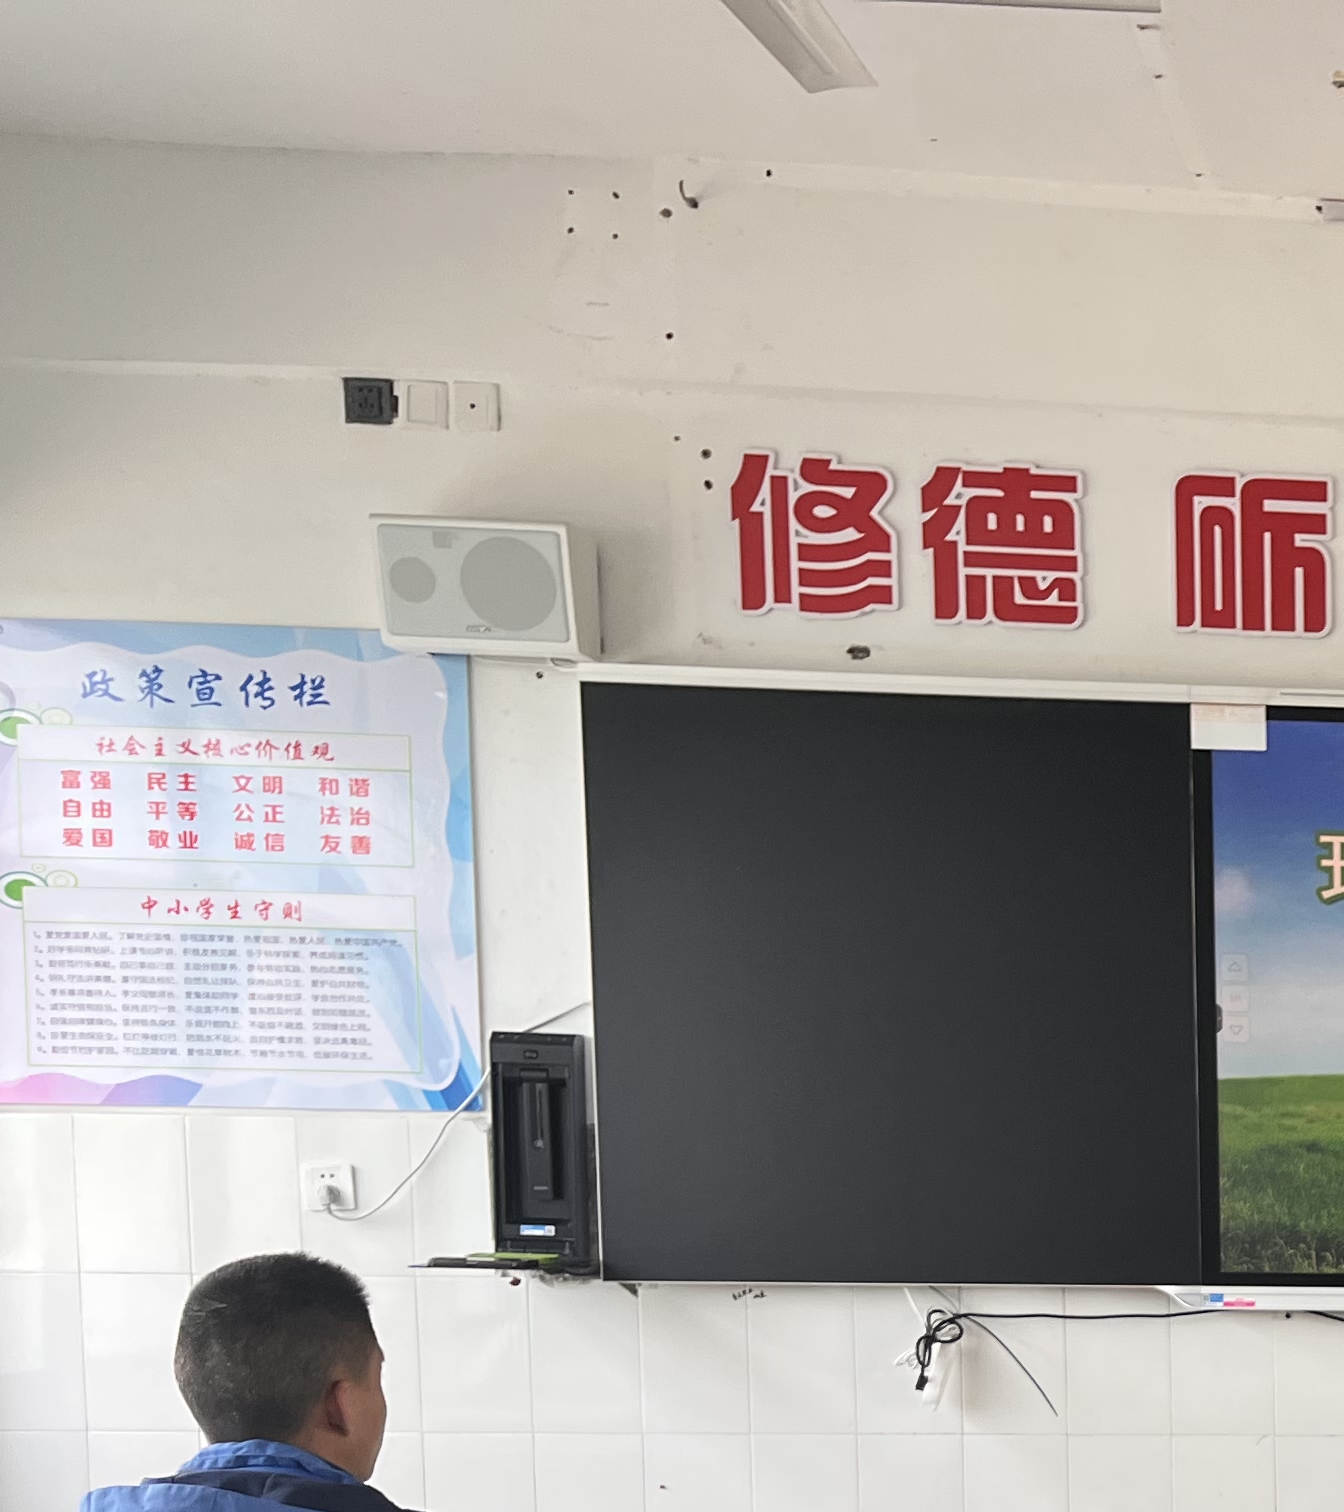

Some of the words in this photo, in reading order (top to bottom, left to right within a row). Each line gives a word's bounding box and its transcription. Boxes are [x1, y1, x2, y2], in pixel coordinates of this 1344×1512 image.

[732, 453, 1082, 627] 修德
[80, 665, 333, 710] 政策宣传栏
[95, 736, 336, 762] 社会主义核心价值观
[60, 770, 113, 791] 富强
[147, 772, 198, 793] 民主
[232, 775, 284, 796] 文明
[318, 777, 370, 798] 和谐
[62, 799, 113, 820] 自由
[147, 801, 198, 822] 平等
[233, 803, 285, 825] 公正
[319, 806, 371, 827] 法治
[62, 828, 114, 849] 爱国
[147, 829, 200, 851] 敬业
[234, 832, 285, 853] 诚信
[320, 834, 372, 855] 友善
[140, 896, 304, 922] 中小学生守则
